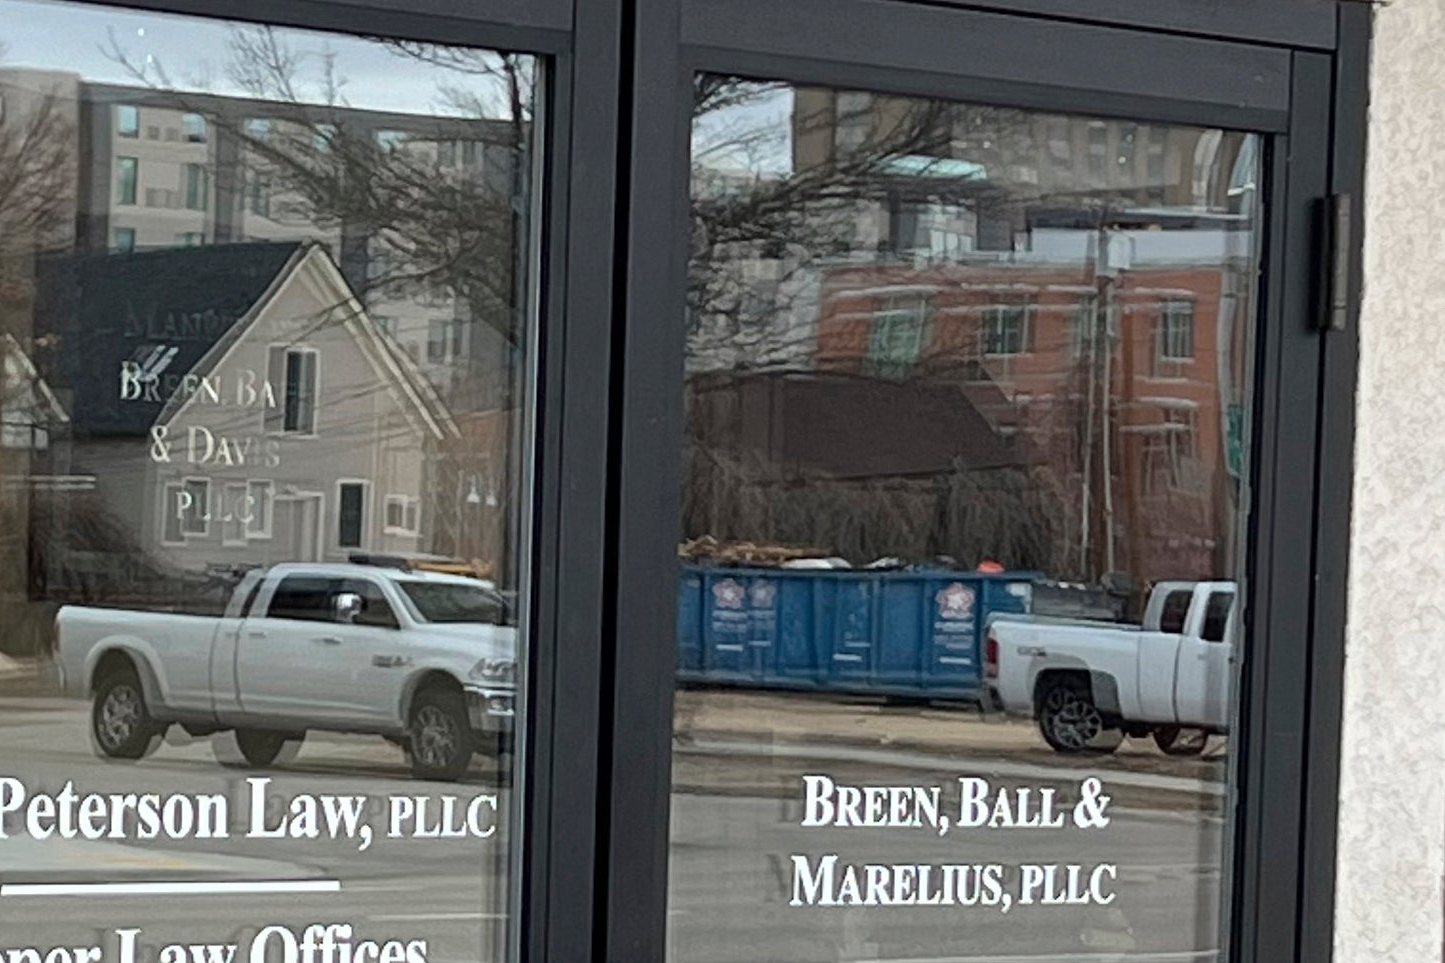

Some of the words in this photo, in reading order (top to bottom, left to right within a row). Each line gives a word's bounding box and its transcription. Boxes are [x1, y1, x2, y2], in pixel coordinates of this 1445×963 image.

[150, 425, 171, 464] &
[245, 777, 372, 851] Law,
[387, 794, 497, 838] PLLC
[801, 775, 949, 836] BREEN,
[956, 777, 1064, 828] BALL
[1073, 777, 1111, 829] &
[789, 855, 1012, 913] MARELIUS,
[1018, 864, 1117, 905] PLLC
